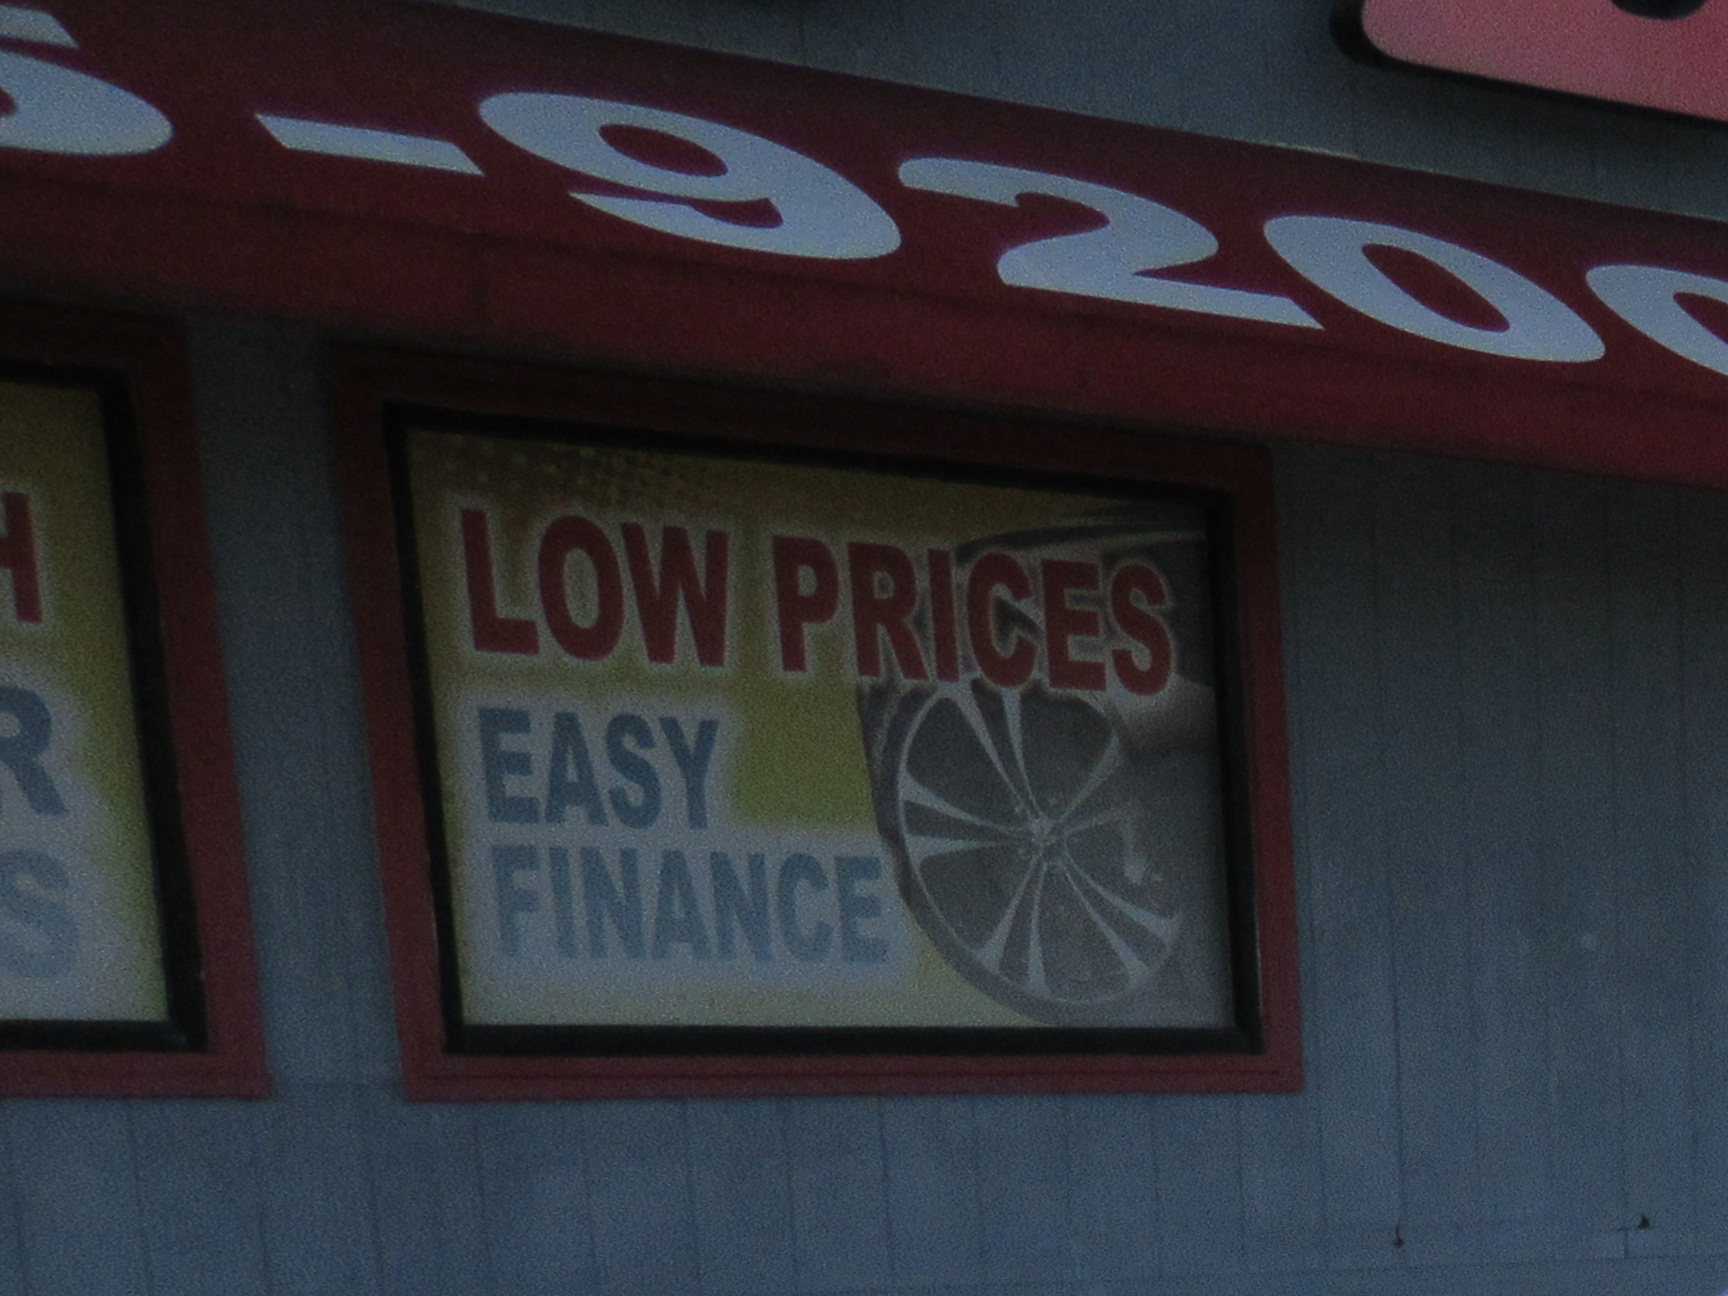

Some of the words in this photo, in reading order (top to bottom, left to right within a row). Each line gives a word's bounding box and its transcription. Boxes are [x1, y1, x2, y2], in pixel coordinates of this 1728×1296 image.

[457, 507, 731, 670] LOW
[770, 533, 1176, 697] PRICES
[476, 707, 720, 830] EASY
[488, 845, 889, 967] FINANCE
